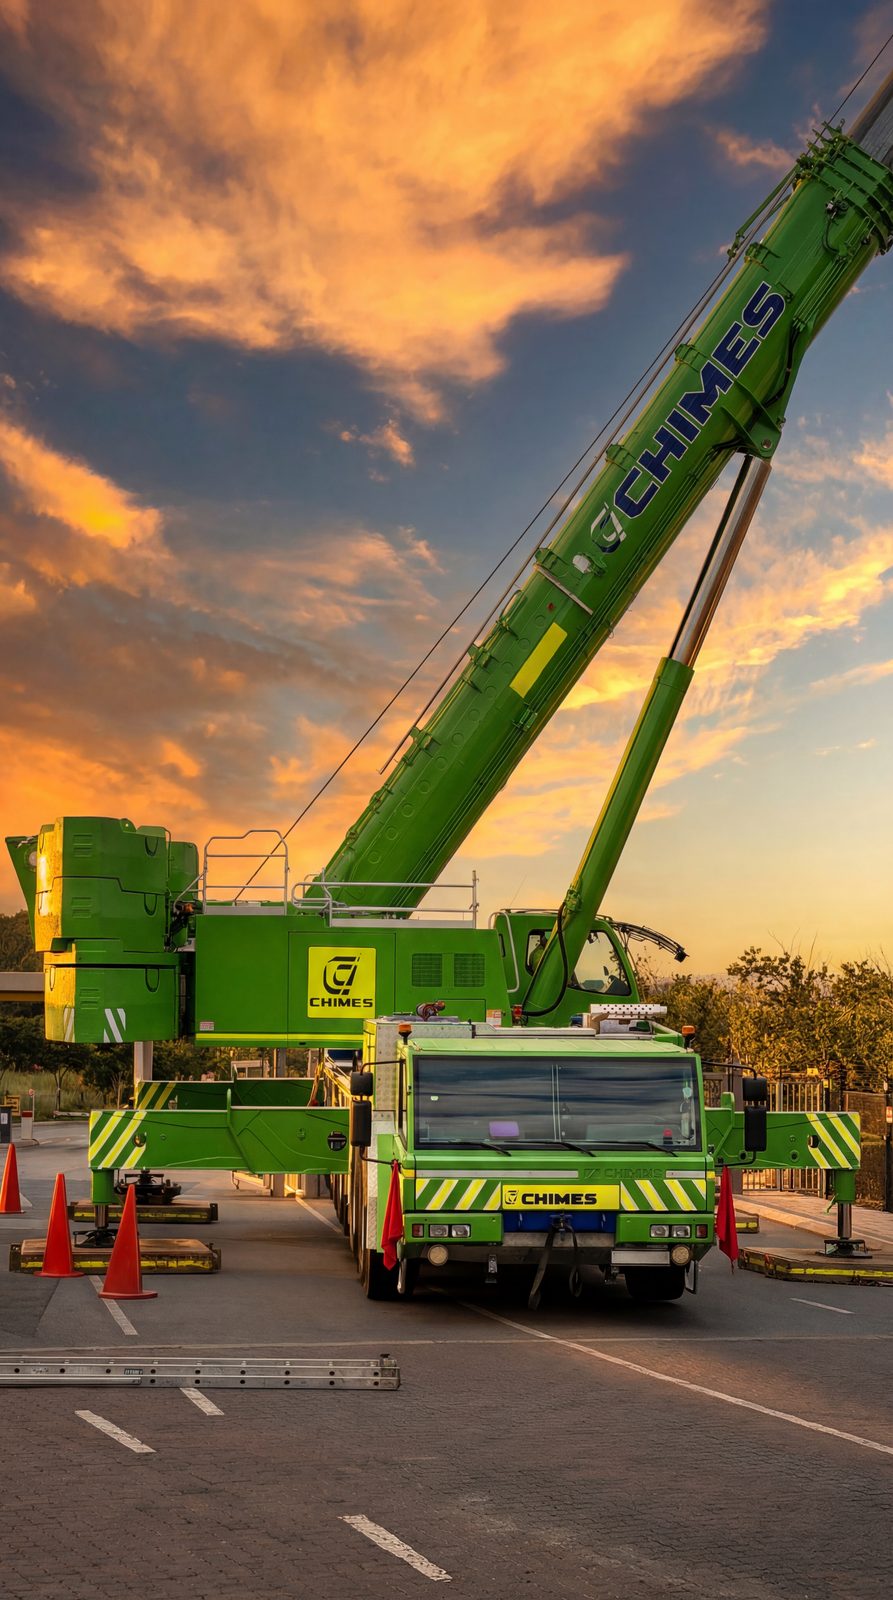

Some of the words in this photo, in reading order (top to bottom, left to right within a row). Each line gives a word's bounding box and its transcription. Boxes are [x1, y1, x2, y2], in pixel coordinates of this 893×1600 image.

[613, 280, 786, 519] CHIMES
[309, 997, 373, 1008] CHIMES
[521, 1193, 597, 1205] CHIMES
